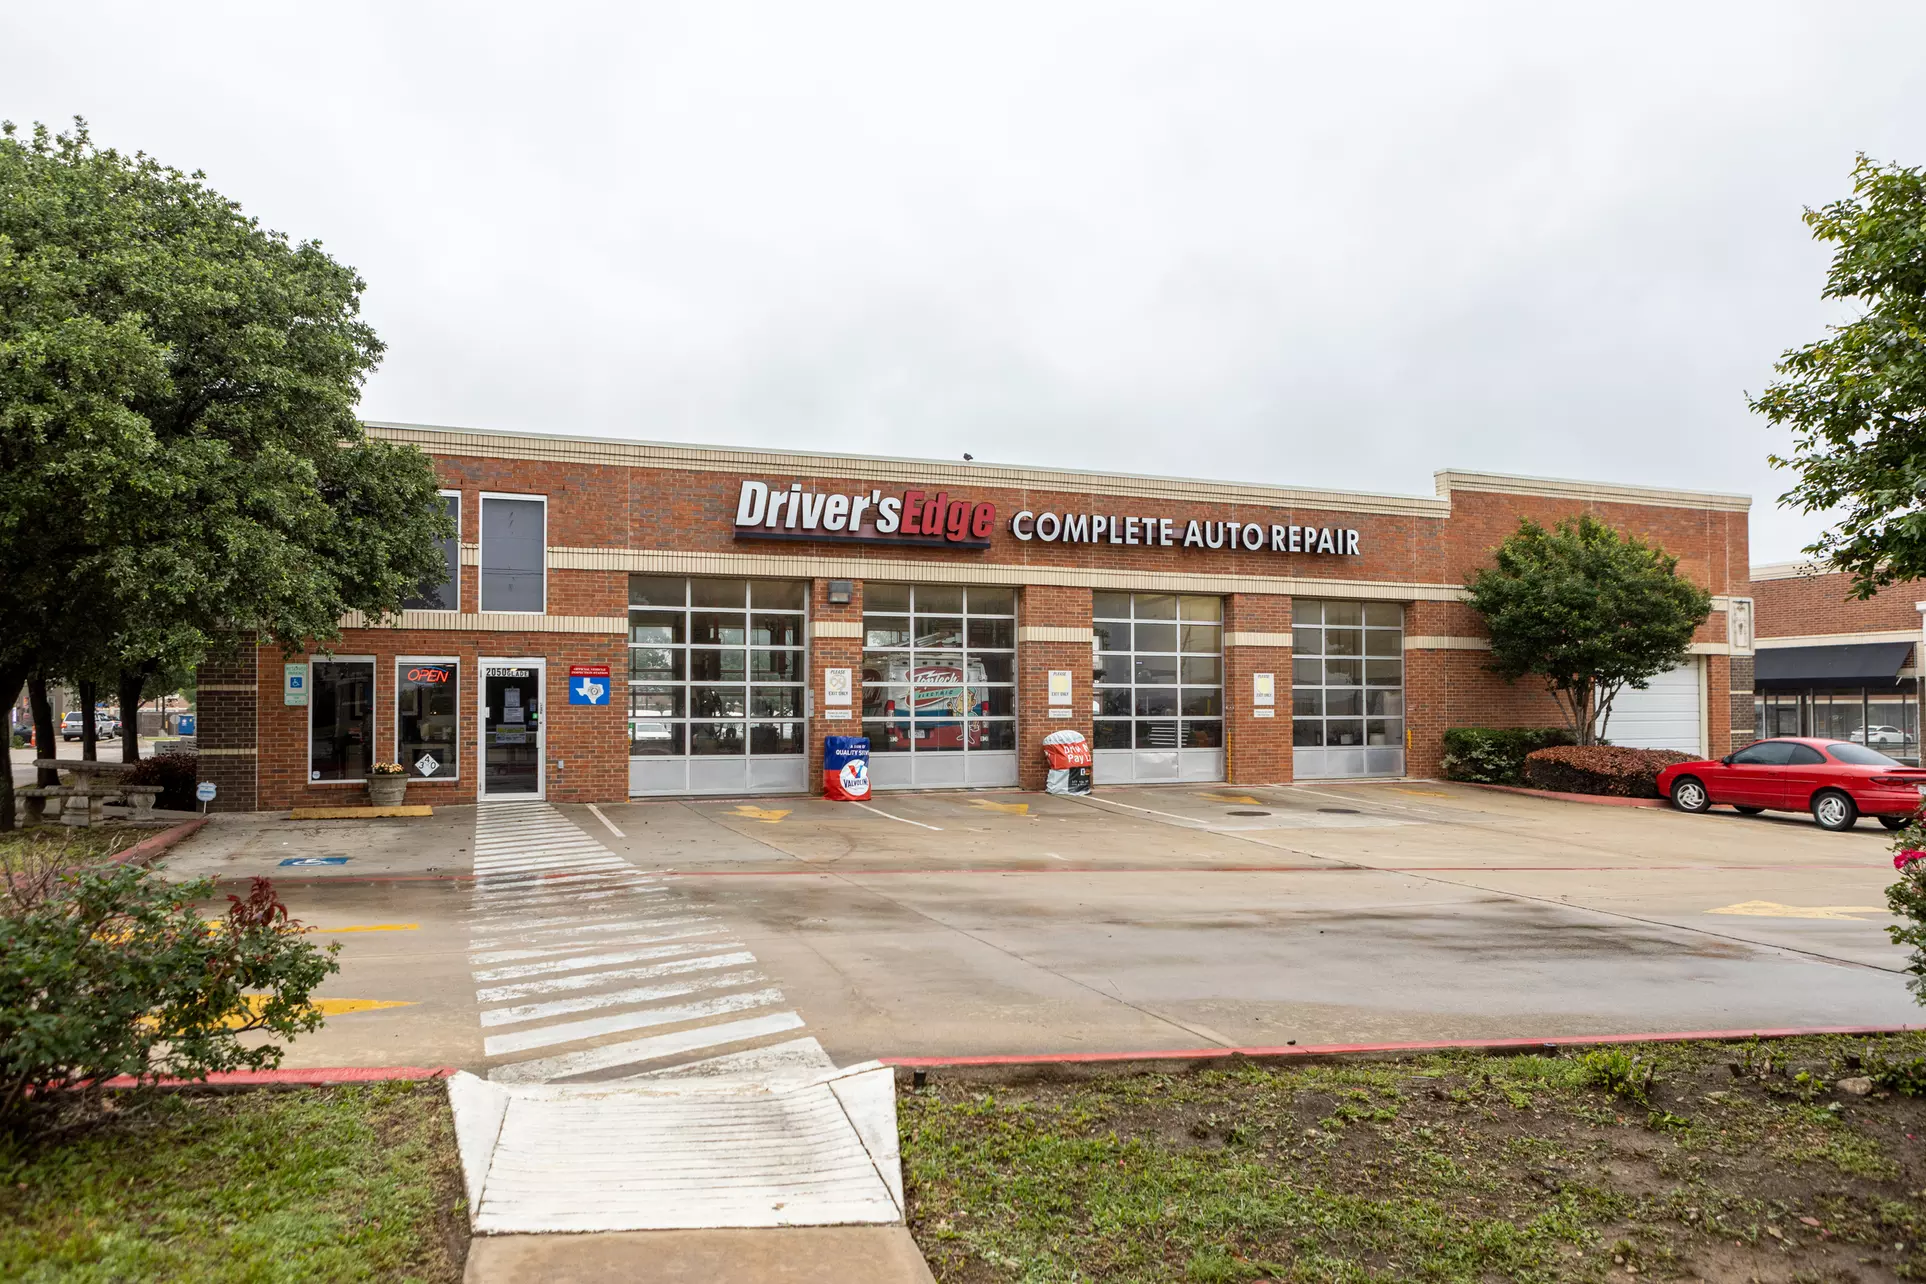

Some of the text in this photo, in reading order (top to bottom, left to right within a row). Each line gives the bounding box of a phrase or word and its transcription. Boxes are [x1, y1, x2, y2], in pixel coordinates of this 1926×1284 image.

[900, 489, 997, 542] Edge
[1012, 510, 1361, 556] COMPLETE AUTO REPAIR
[407, 668, 450, 682] OPEN
[486, 668, 507, 677] 2050
[917, 689, 954, 699] ELECTRIC
[1067, 753, 1084, 764] Pay
